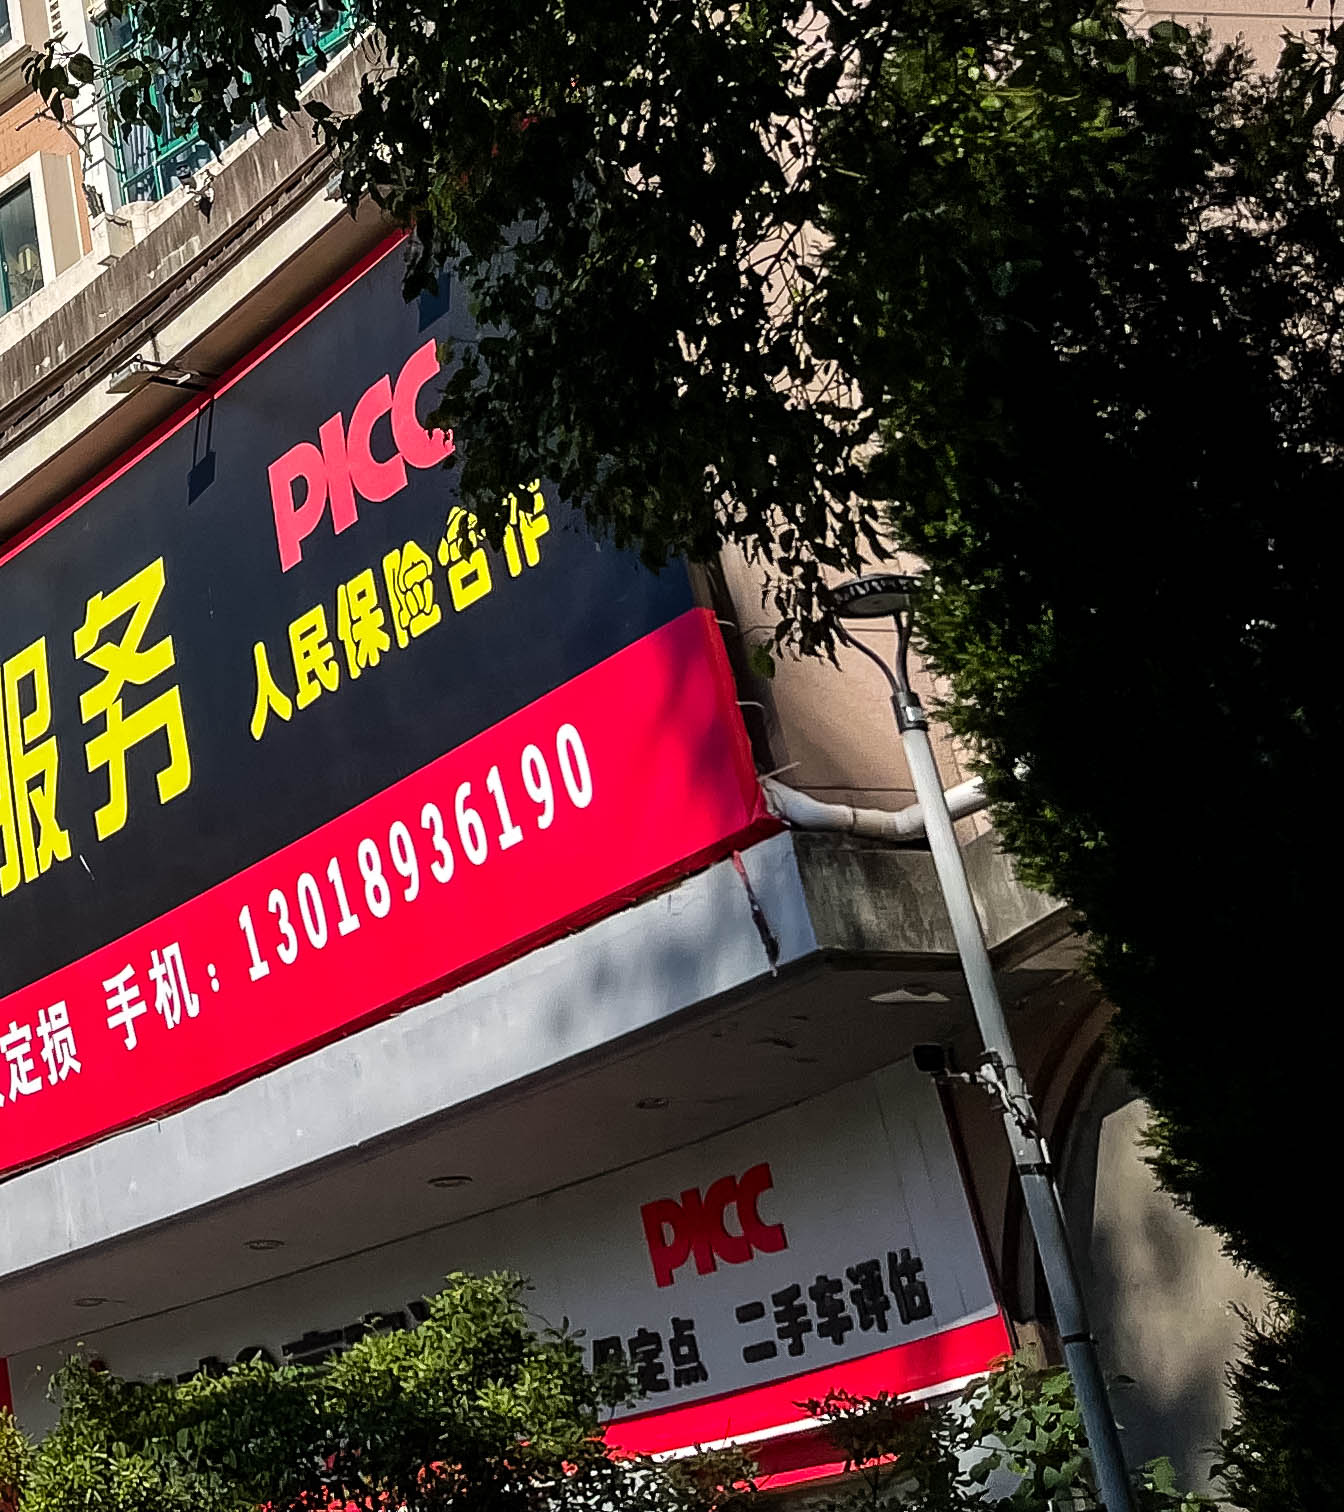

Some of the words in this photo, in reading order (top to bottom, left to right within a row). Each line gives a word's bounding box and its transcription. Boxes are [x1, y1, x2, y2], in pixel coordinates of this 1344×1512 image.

[268, 337, 456, 574] PICC
[640, 1162, 787, 1288] PICC
[736, 1248, 933, 1363] 二手车评估
